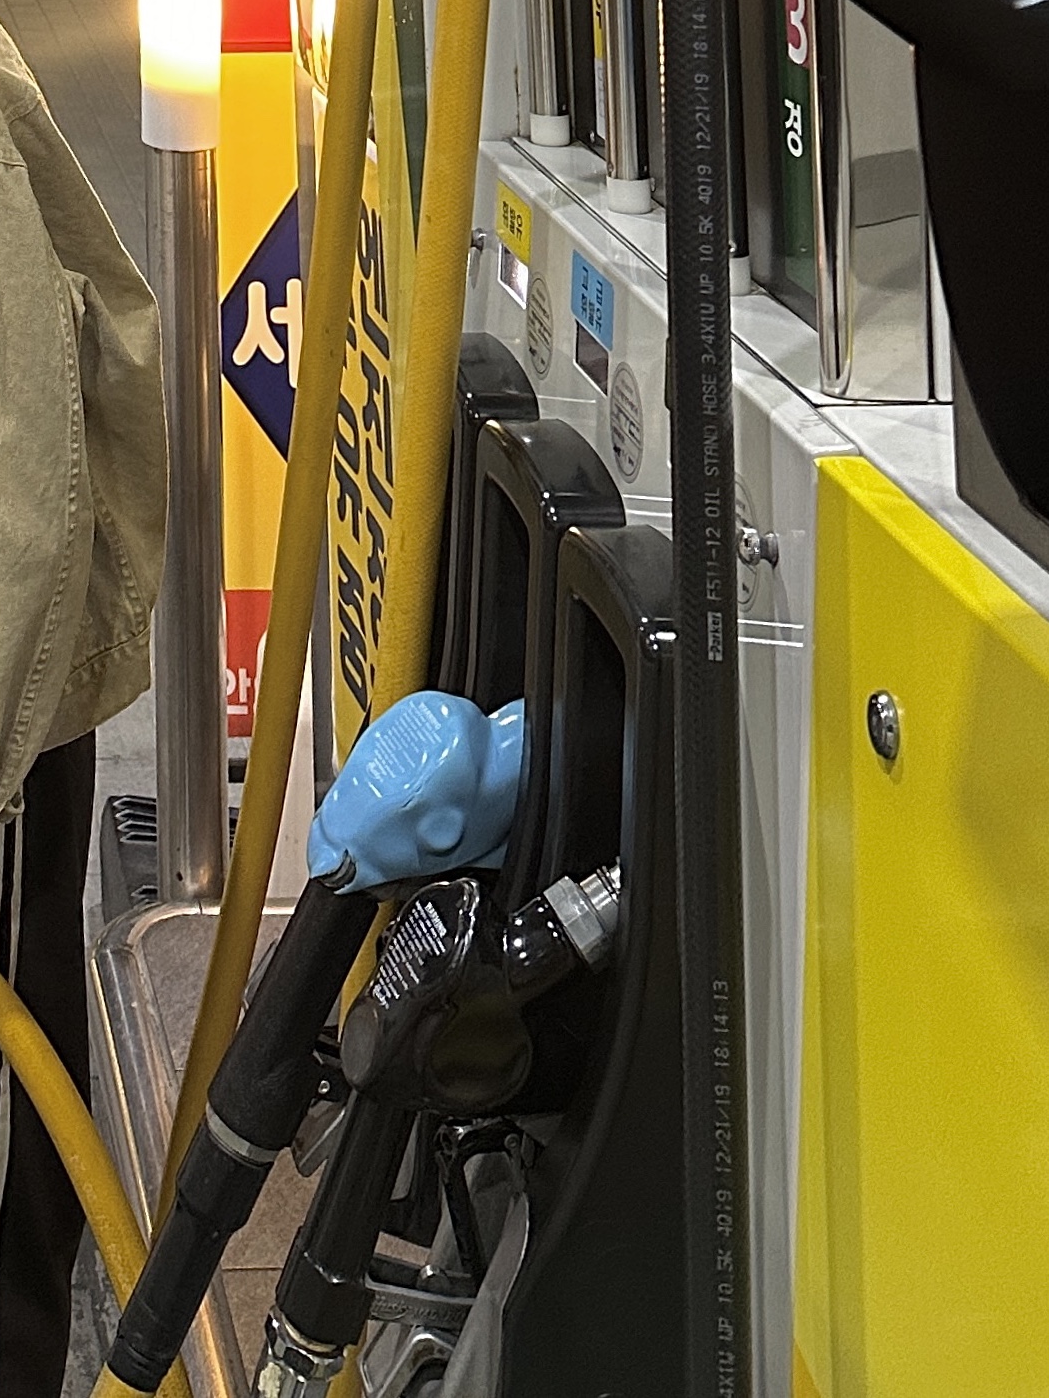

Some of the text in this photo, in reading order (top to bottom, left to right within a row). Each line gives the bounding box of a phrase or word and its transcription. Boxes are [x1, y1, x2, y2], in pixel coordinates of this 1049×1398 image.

[694, 72, 712, 150] 12/21/19
[701, 373, 718, 416] HOSE
[703, 423, 720, 477] STAND
[704, 487, 721, 518] OIL
[705, 526, 722, 601] F511-12
[706, 611, 724, 662] Parker
[714, 1084, 732, 1173] 12/21/19
